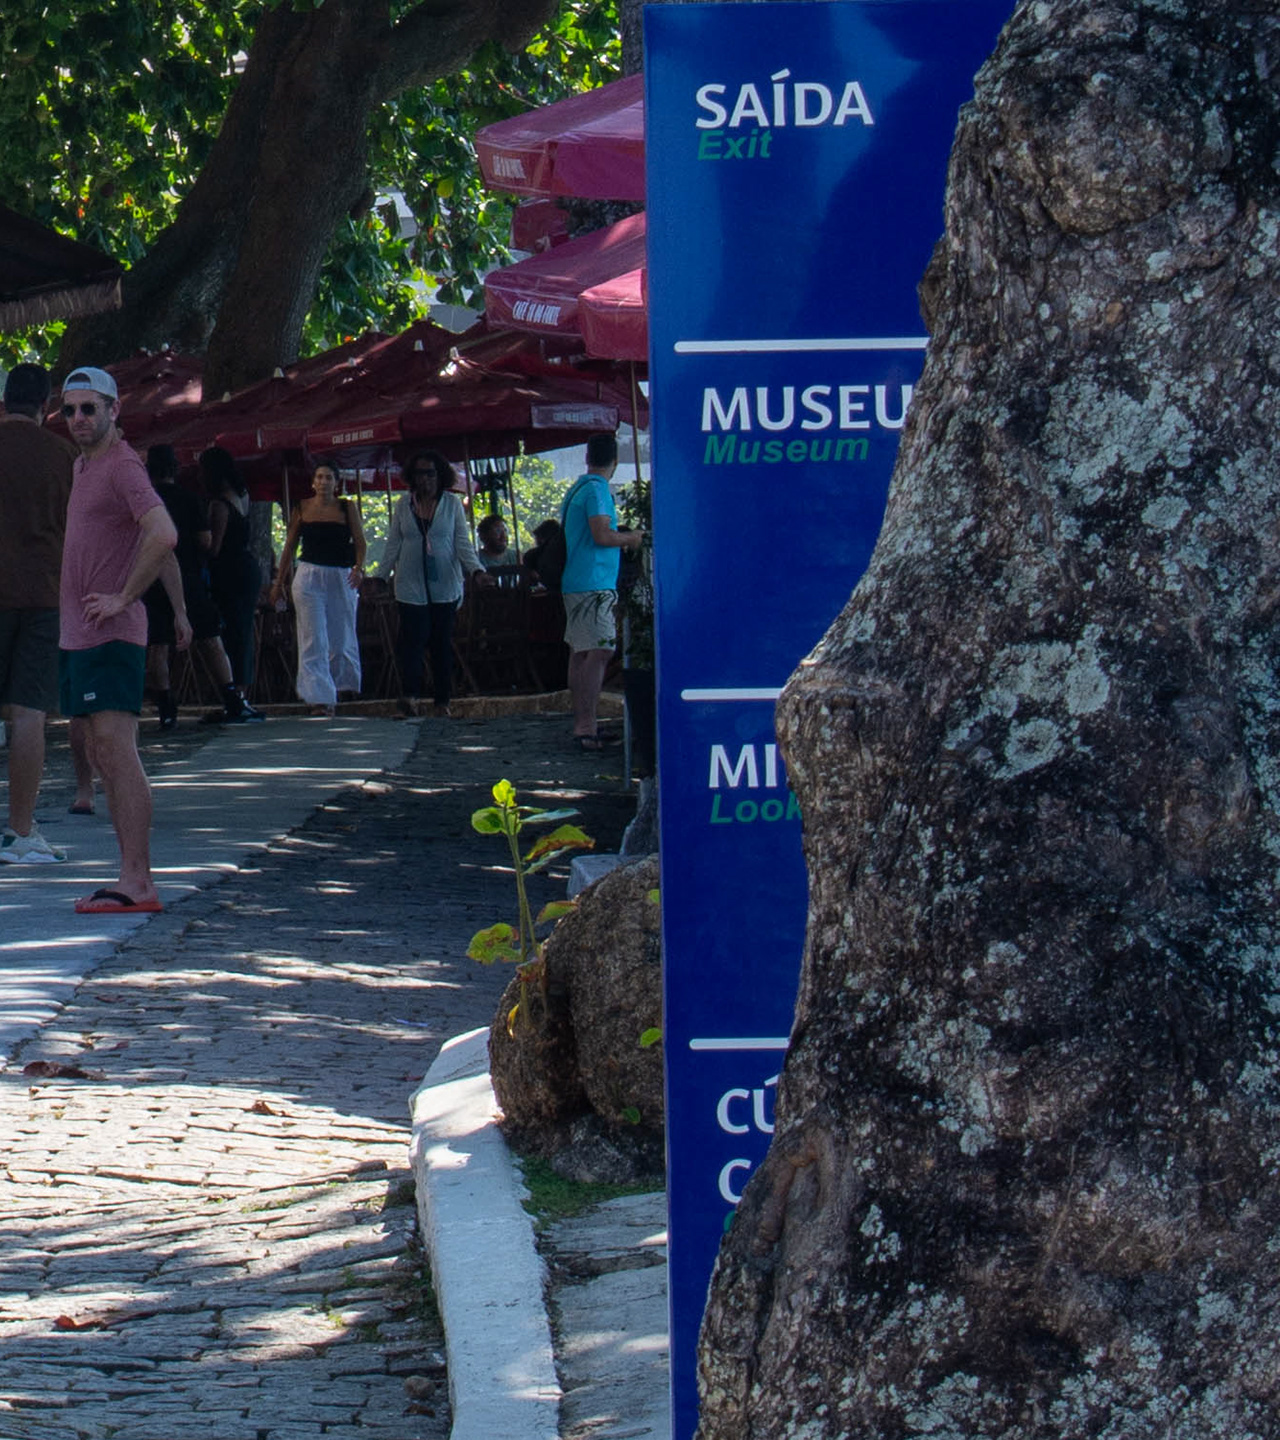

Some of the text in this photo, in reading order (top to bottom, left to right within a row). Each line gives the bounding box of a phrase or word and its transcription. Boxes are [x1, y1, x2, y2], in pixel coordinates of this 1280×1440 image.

[695, 68, 874, 128] SAÍDA
[697, 128, 773, 161] Exit
[701, 384, 914, 432] MUSEU
[703, 434, 870, 465] Museum
